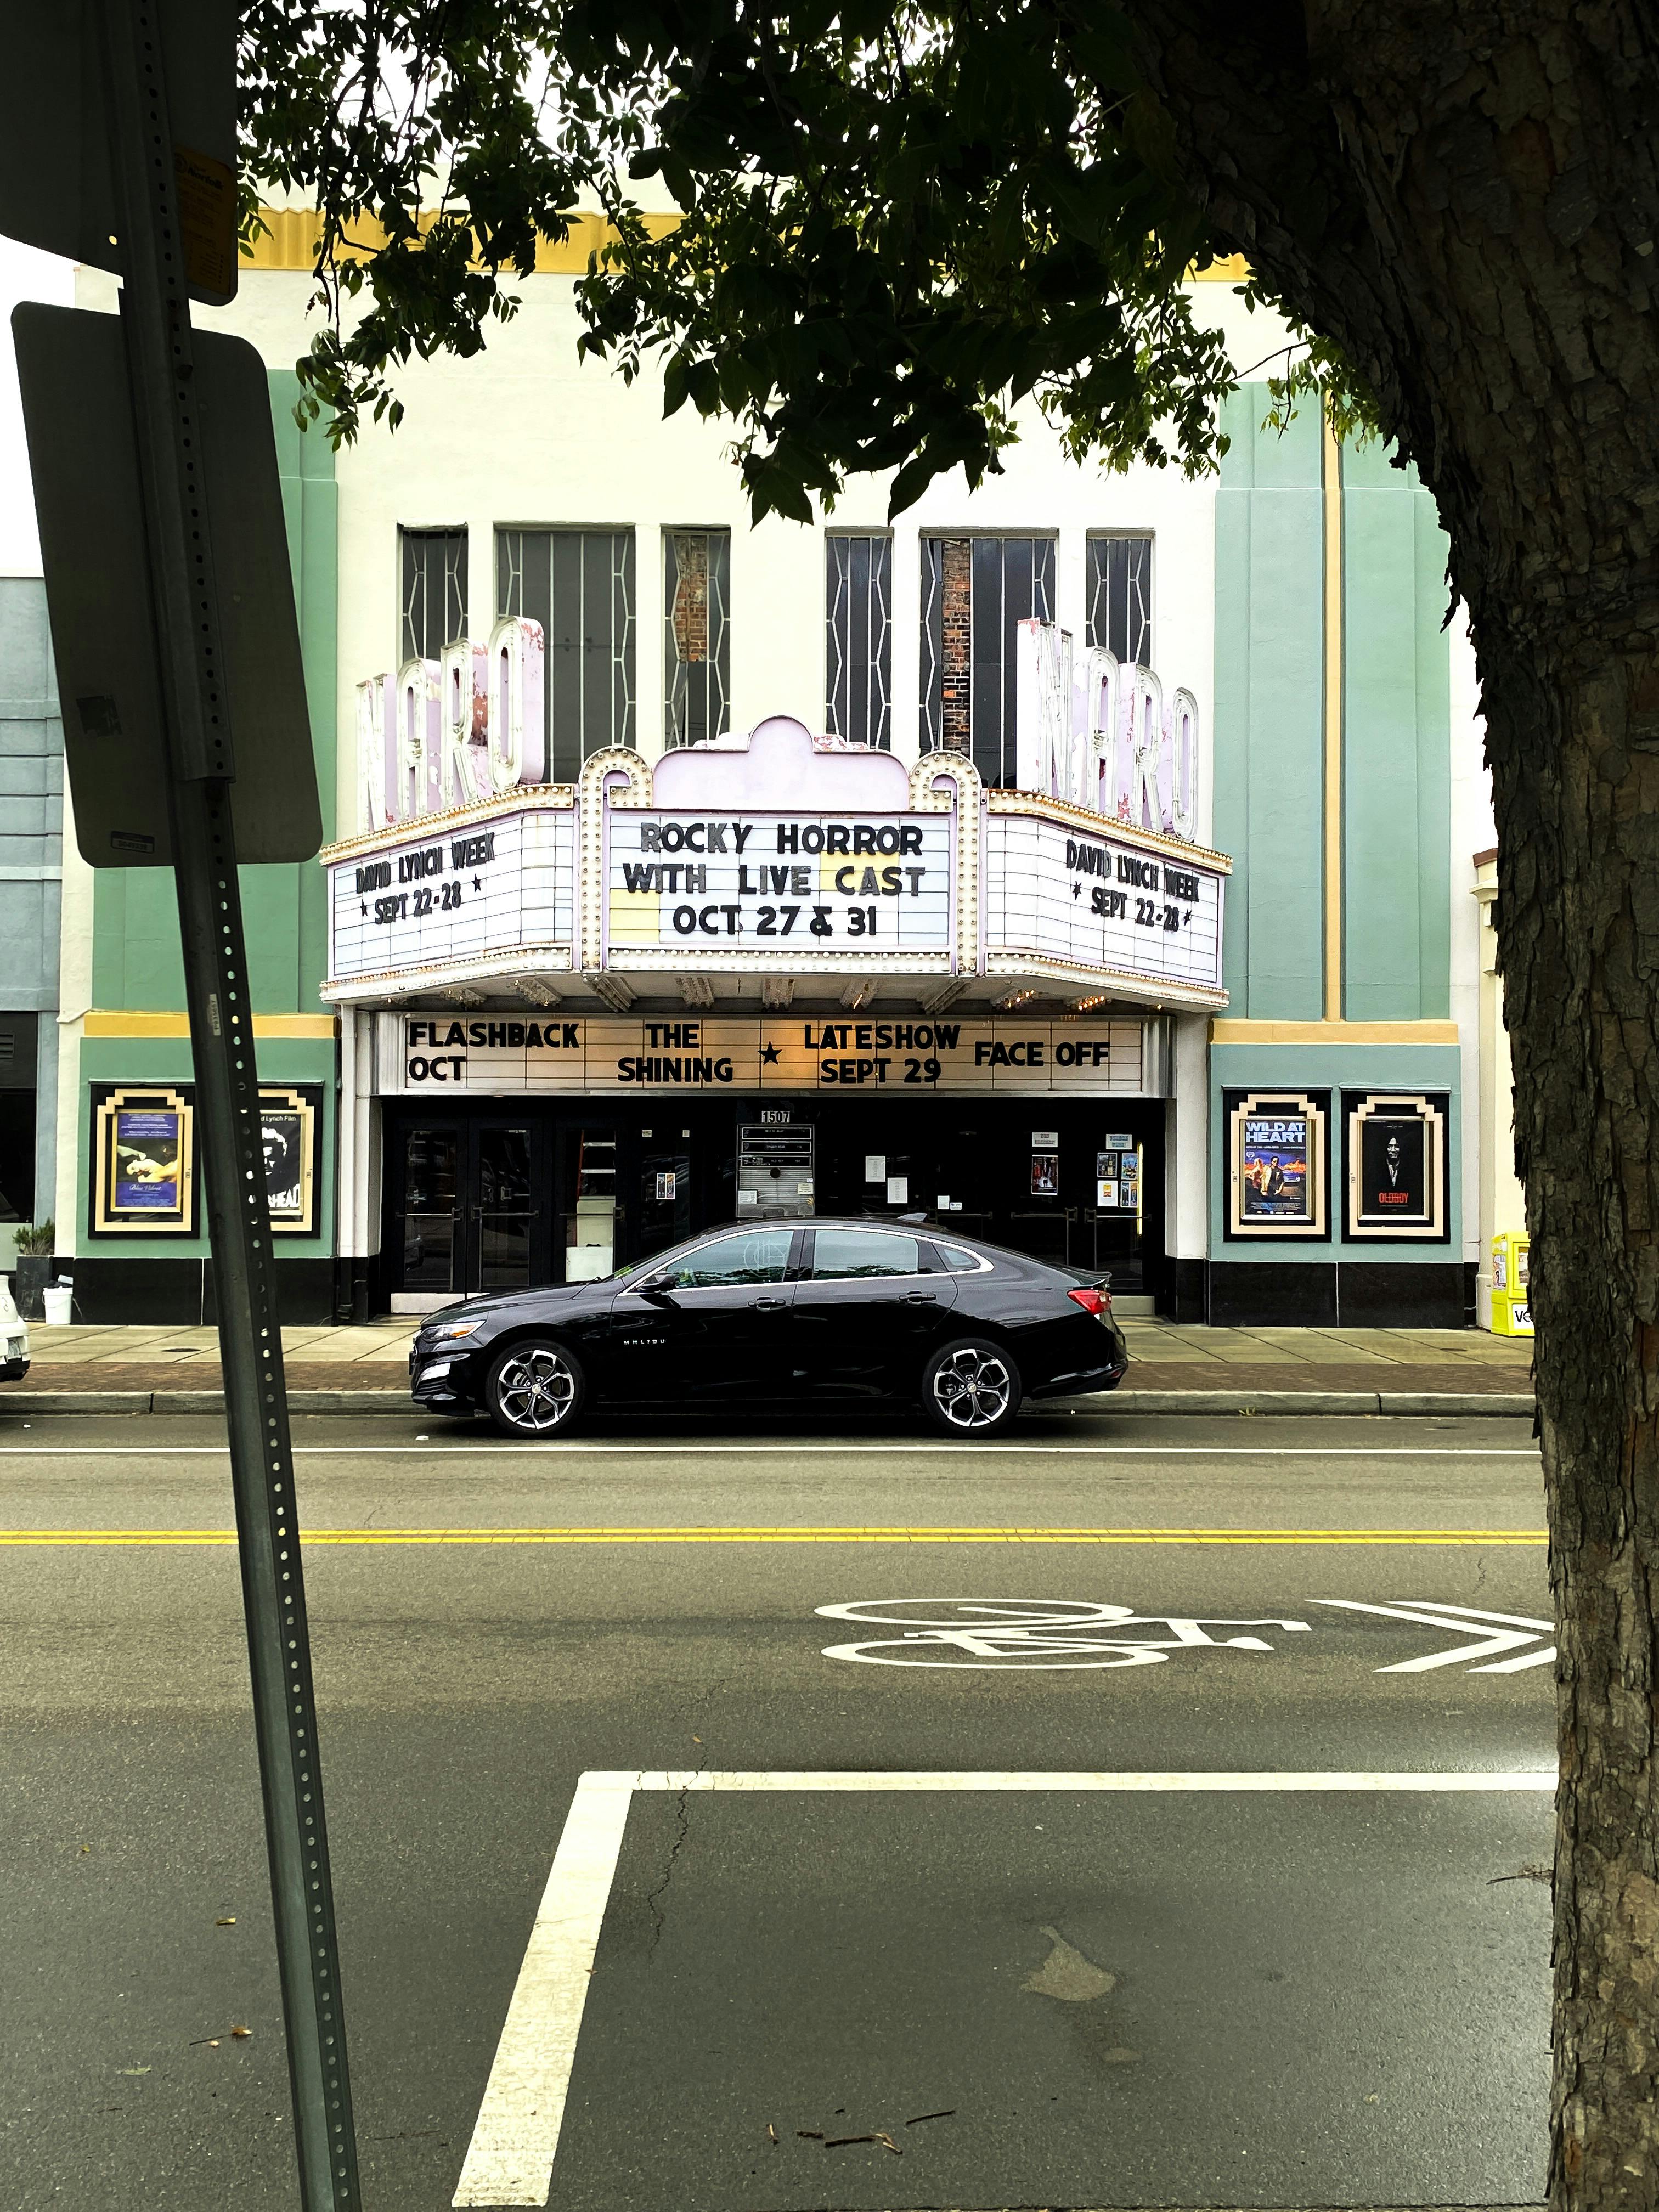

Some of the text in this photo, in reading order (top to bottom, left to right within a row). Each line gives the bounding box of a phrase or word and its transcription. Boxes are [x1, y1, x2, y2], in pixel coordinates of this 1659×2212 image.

[356, 616, 543, 834] NARO
[1018, 618, 1198, 840] NARO
[641, 822, 923, 855] ROCKY HORROR
[356, 832, 495, 894] DAVID LYNCH WEEK
[1066, 839, 1200, 902] DAVID LYNCH WEEK
[623, 863, 925, 896] WITH LIVE CAST
[375, 881, 461, 924] SEPT 22-28
[1091, 887, 1180, 932] SEPT 22-28
[673, 905, 877, 936] OCT 27 & 31
[409, 1022, 580, 1048] FLASHBACK
[645, 1024, 699, 1049] THE
[804, 1024, 961, 1051] LATESHOW
[974, 1041, 1110, 1067] FACE OFF
[408, 1056, 466, 1081] OCT
[617, 1057, 733, 1082] SHINING
[820, 1058, 942, 1084] SEPT 29
[763, 1111, 789, 1122] 1507
[1246, 1122, 1306, 1132] WILD AT
[1246, 1131, 1306, 1143] HEART
[268, 1183, 300, 1207] RHEAD
[1378, 1192, 1409, 1203] OLDBOY
